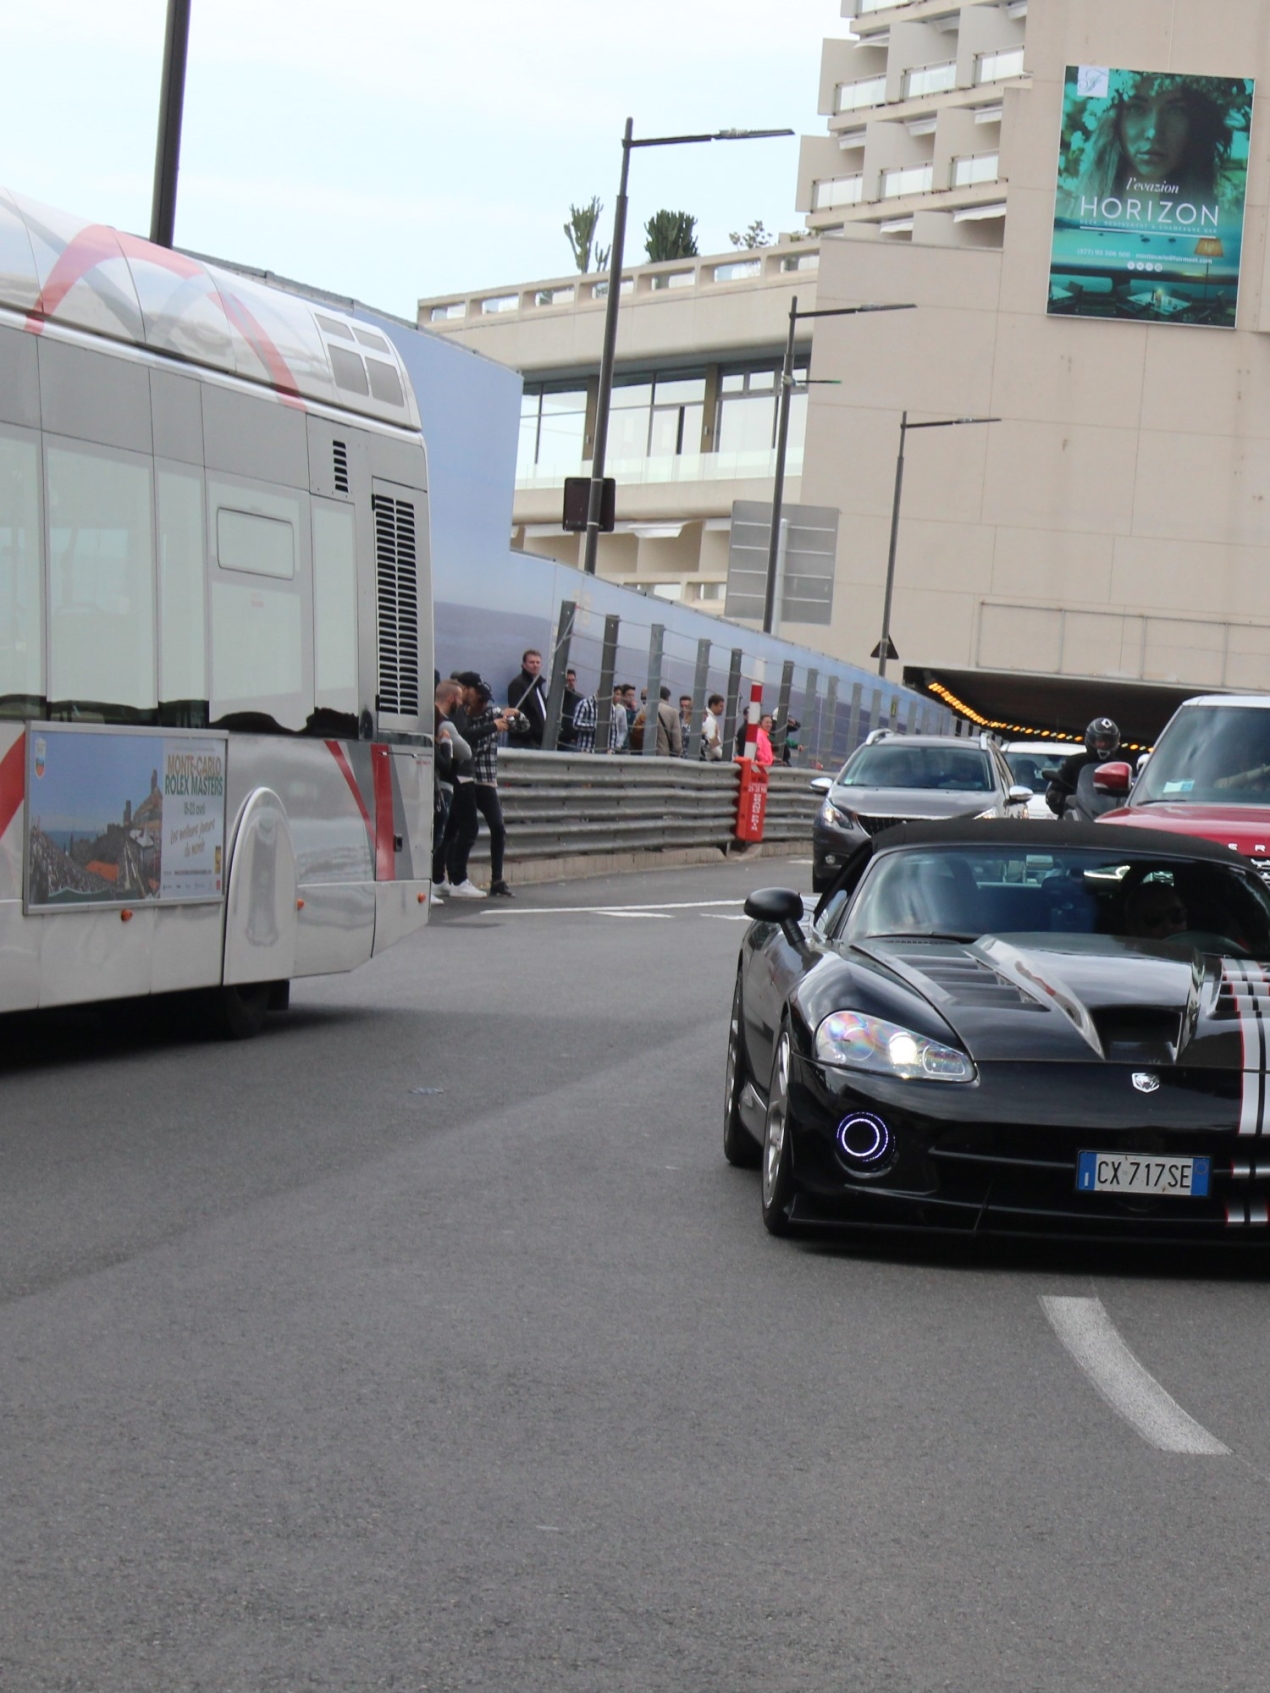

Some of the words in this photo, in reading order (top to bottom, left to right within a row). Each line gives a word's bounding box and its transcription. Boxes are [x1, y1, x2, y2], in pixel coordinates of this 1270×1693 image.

[1080, 196, 1219, 227] HORIZON
[1104, 220, 1149, 229] RESTAURANT
[1159, 224, 1200, 233] CHAMPAGNE
[167, 754, 222, 776] MONTE-CARLO
[165, 774, 189, 796] ROLEX
[191, 775, 223, 797] MASTERS
